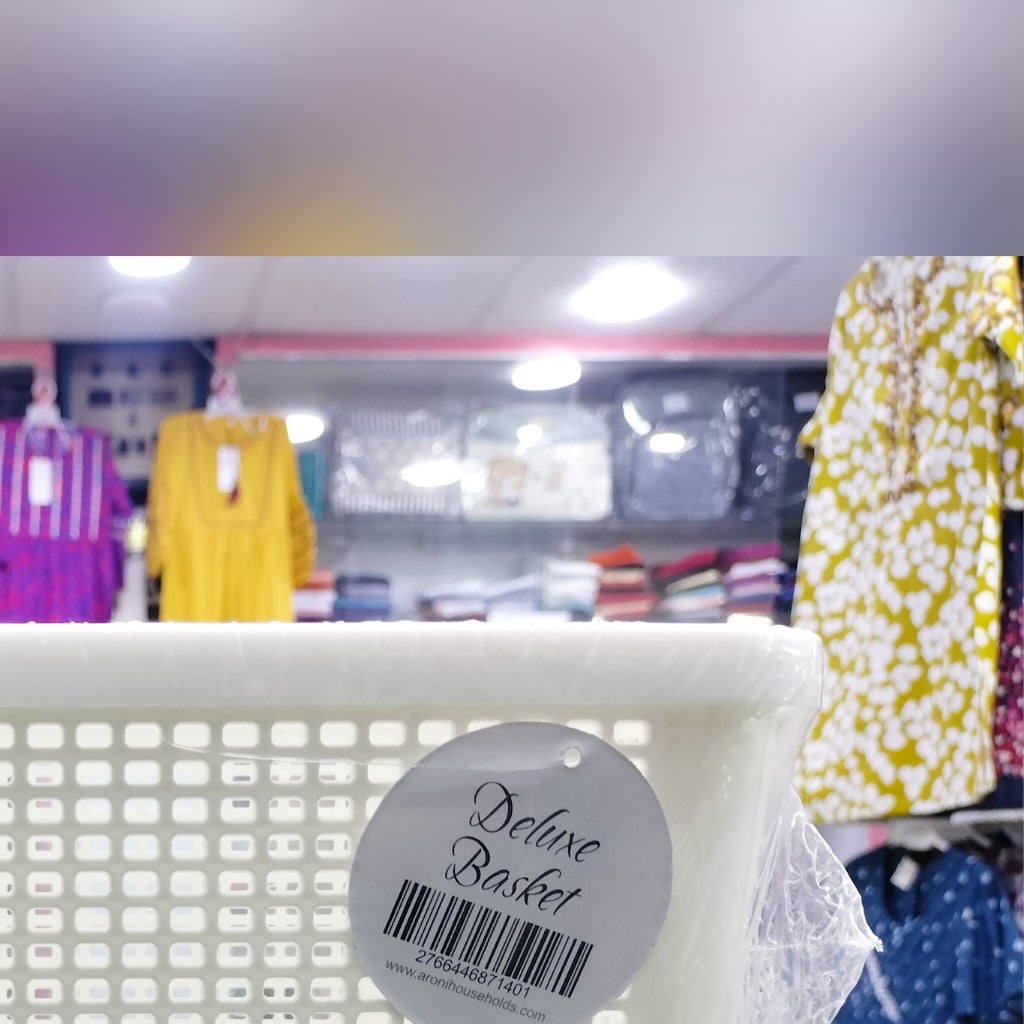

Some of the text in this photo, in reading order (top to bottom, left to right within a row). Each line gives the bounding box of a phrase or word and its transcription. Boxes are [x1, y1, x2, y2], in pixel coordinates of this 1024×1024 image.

[470, 781, 601, 862] Deluxe
[445, 835, 582, 916] Basket
[385, 959, 546, 1023] www.aronihouseholds.com
[414, 950, 531, 999] 2766446871401
